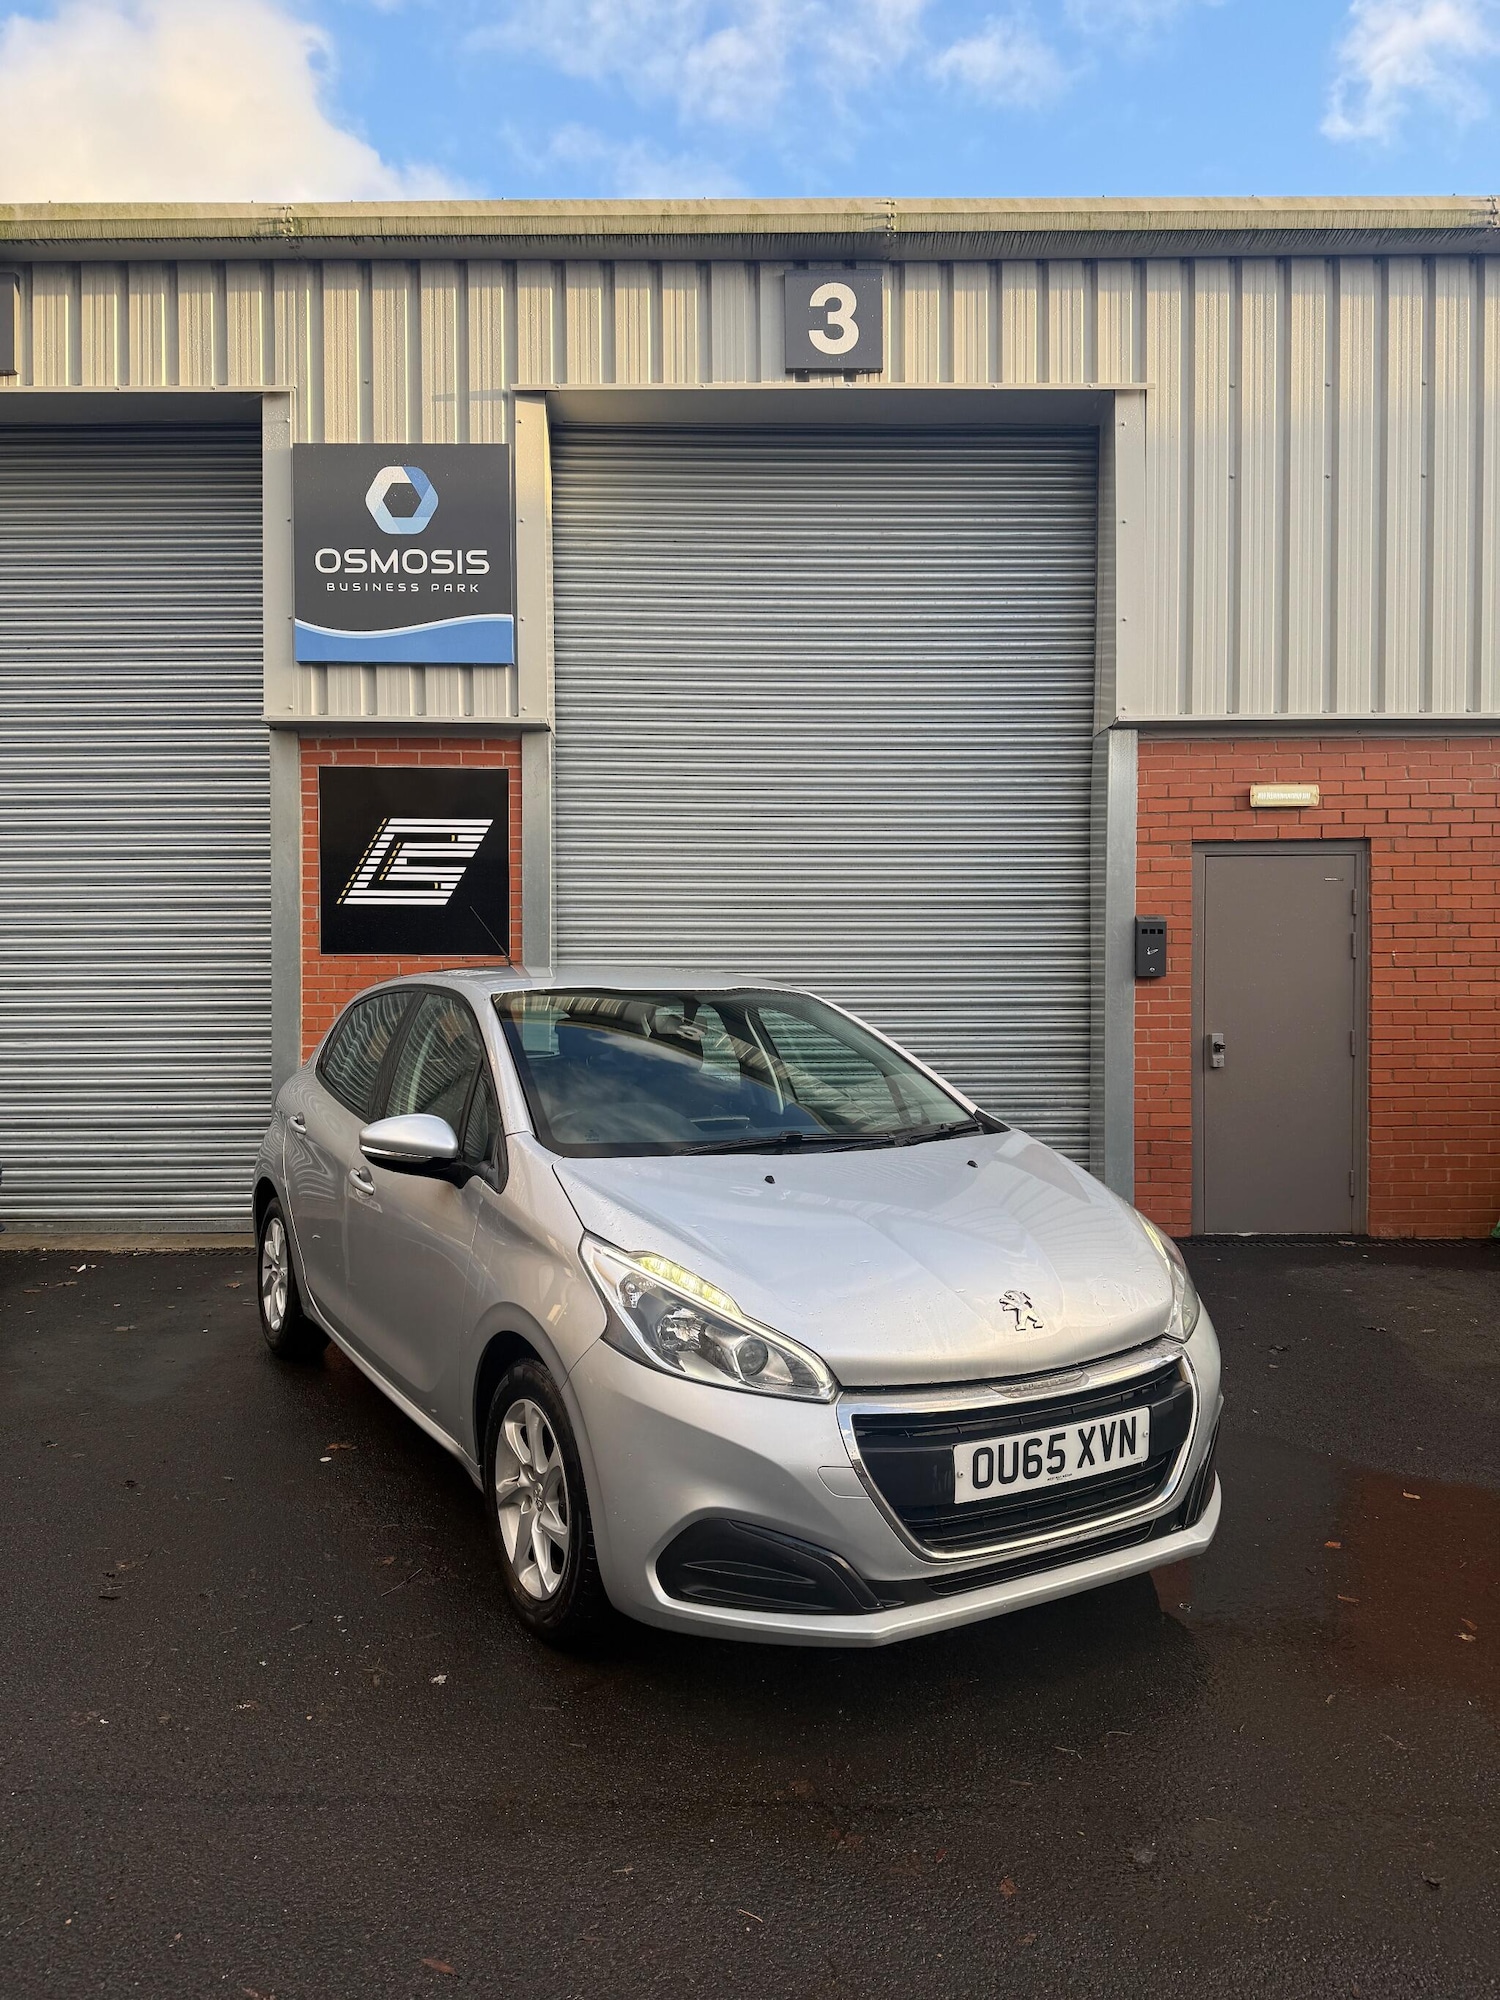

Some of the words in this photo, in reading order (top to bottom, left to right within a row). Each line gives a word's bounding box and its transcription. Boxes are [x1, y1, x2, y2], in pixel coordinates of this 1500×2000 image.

[808, 282, 860, 355] 3
[314, 547, 490, 575] OSMOSIS
[326, 582, 420, 592] BUSINESS
[431, 583, 479, 593] PARK
[972, 1432, 1066, 1490] OU65
[1077, 1416, 1137, 1469] XVN
